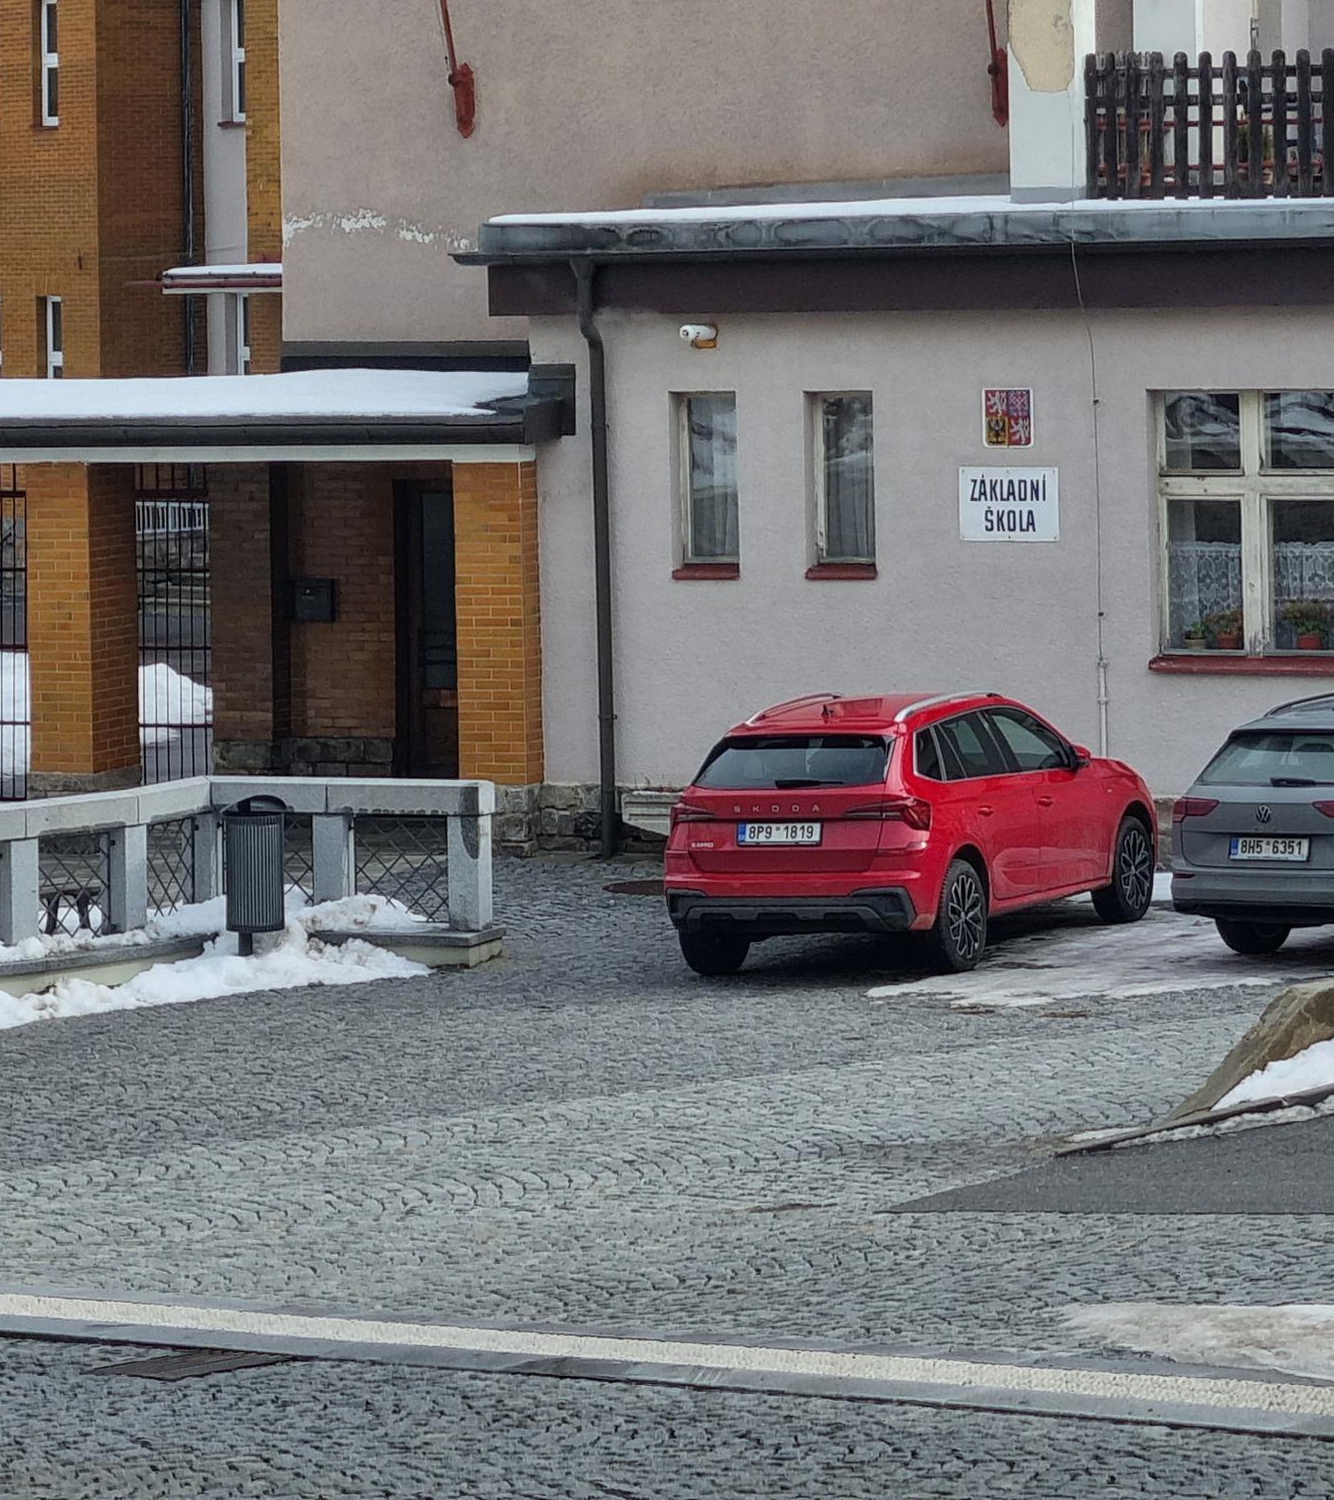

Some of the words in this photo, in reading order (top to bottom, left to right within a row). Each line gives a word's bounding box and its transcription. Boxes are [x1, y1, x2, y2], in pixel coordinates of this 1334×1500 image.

[970, 473, 1047, 502] ZÁKLADNÍ
[984, 506, 1036, 533] ŠKOLA
[748, 825, 772, 840] 8P9
[783, 825, 814, 839] 1819
[1240, 840, 1263, 854] 8H5
[1272, 840, 1302, 855] 6351
